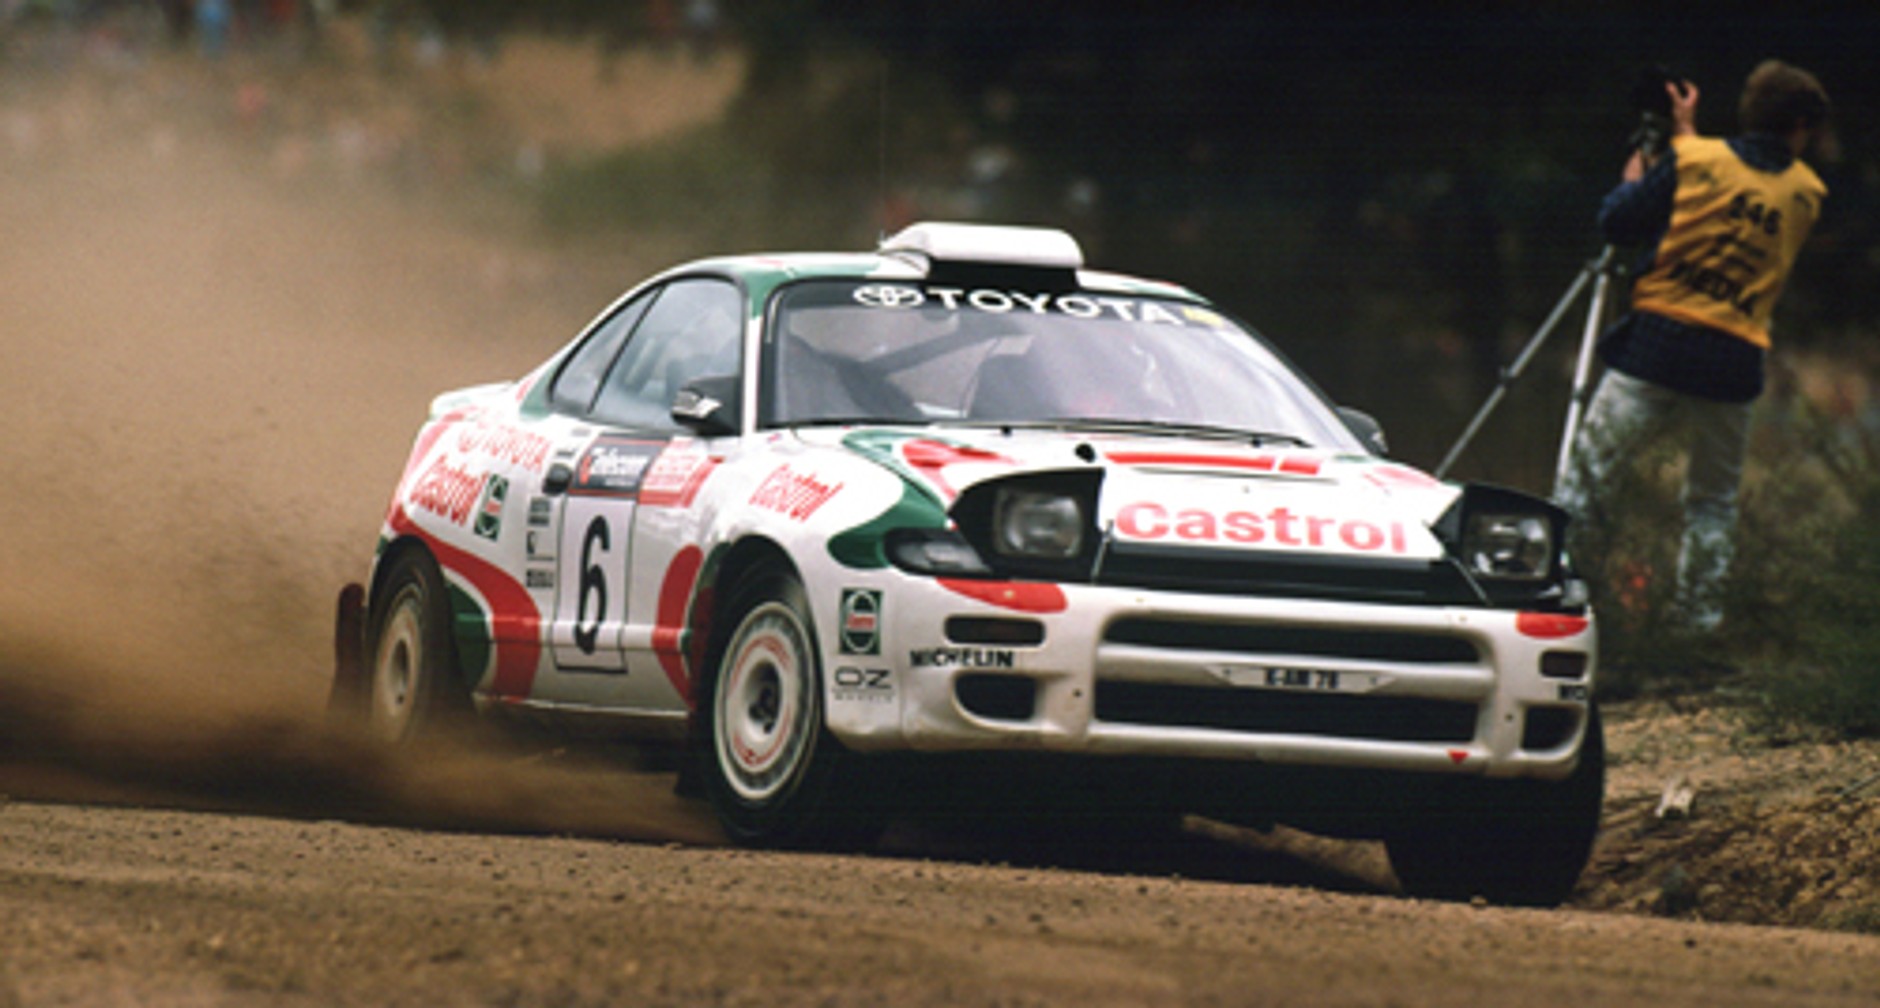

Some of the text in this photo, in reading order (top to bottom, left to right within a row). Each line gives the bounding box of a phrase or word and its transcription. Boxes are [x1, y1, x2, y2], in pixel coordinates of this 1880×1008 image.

[928, 288, 1184, 326] TOYOTA
[410, 454, 490, 527] Castrol
[748, 463, 845, 524] Castrol
[1115, 502, 1407, 554] Castrol
[575, 514, 611, 656] 6
[835, 666, 892, 689] OZ
[910, 648, 1013, 668] MICHELIN
